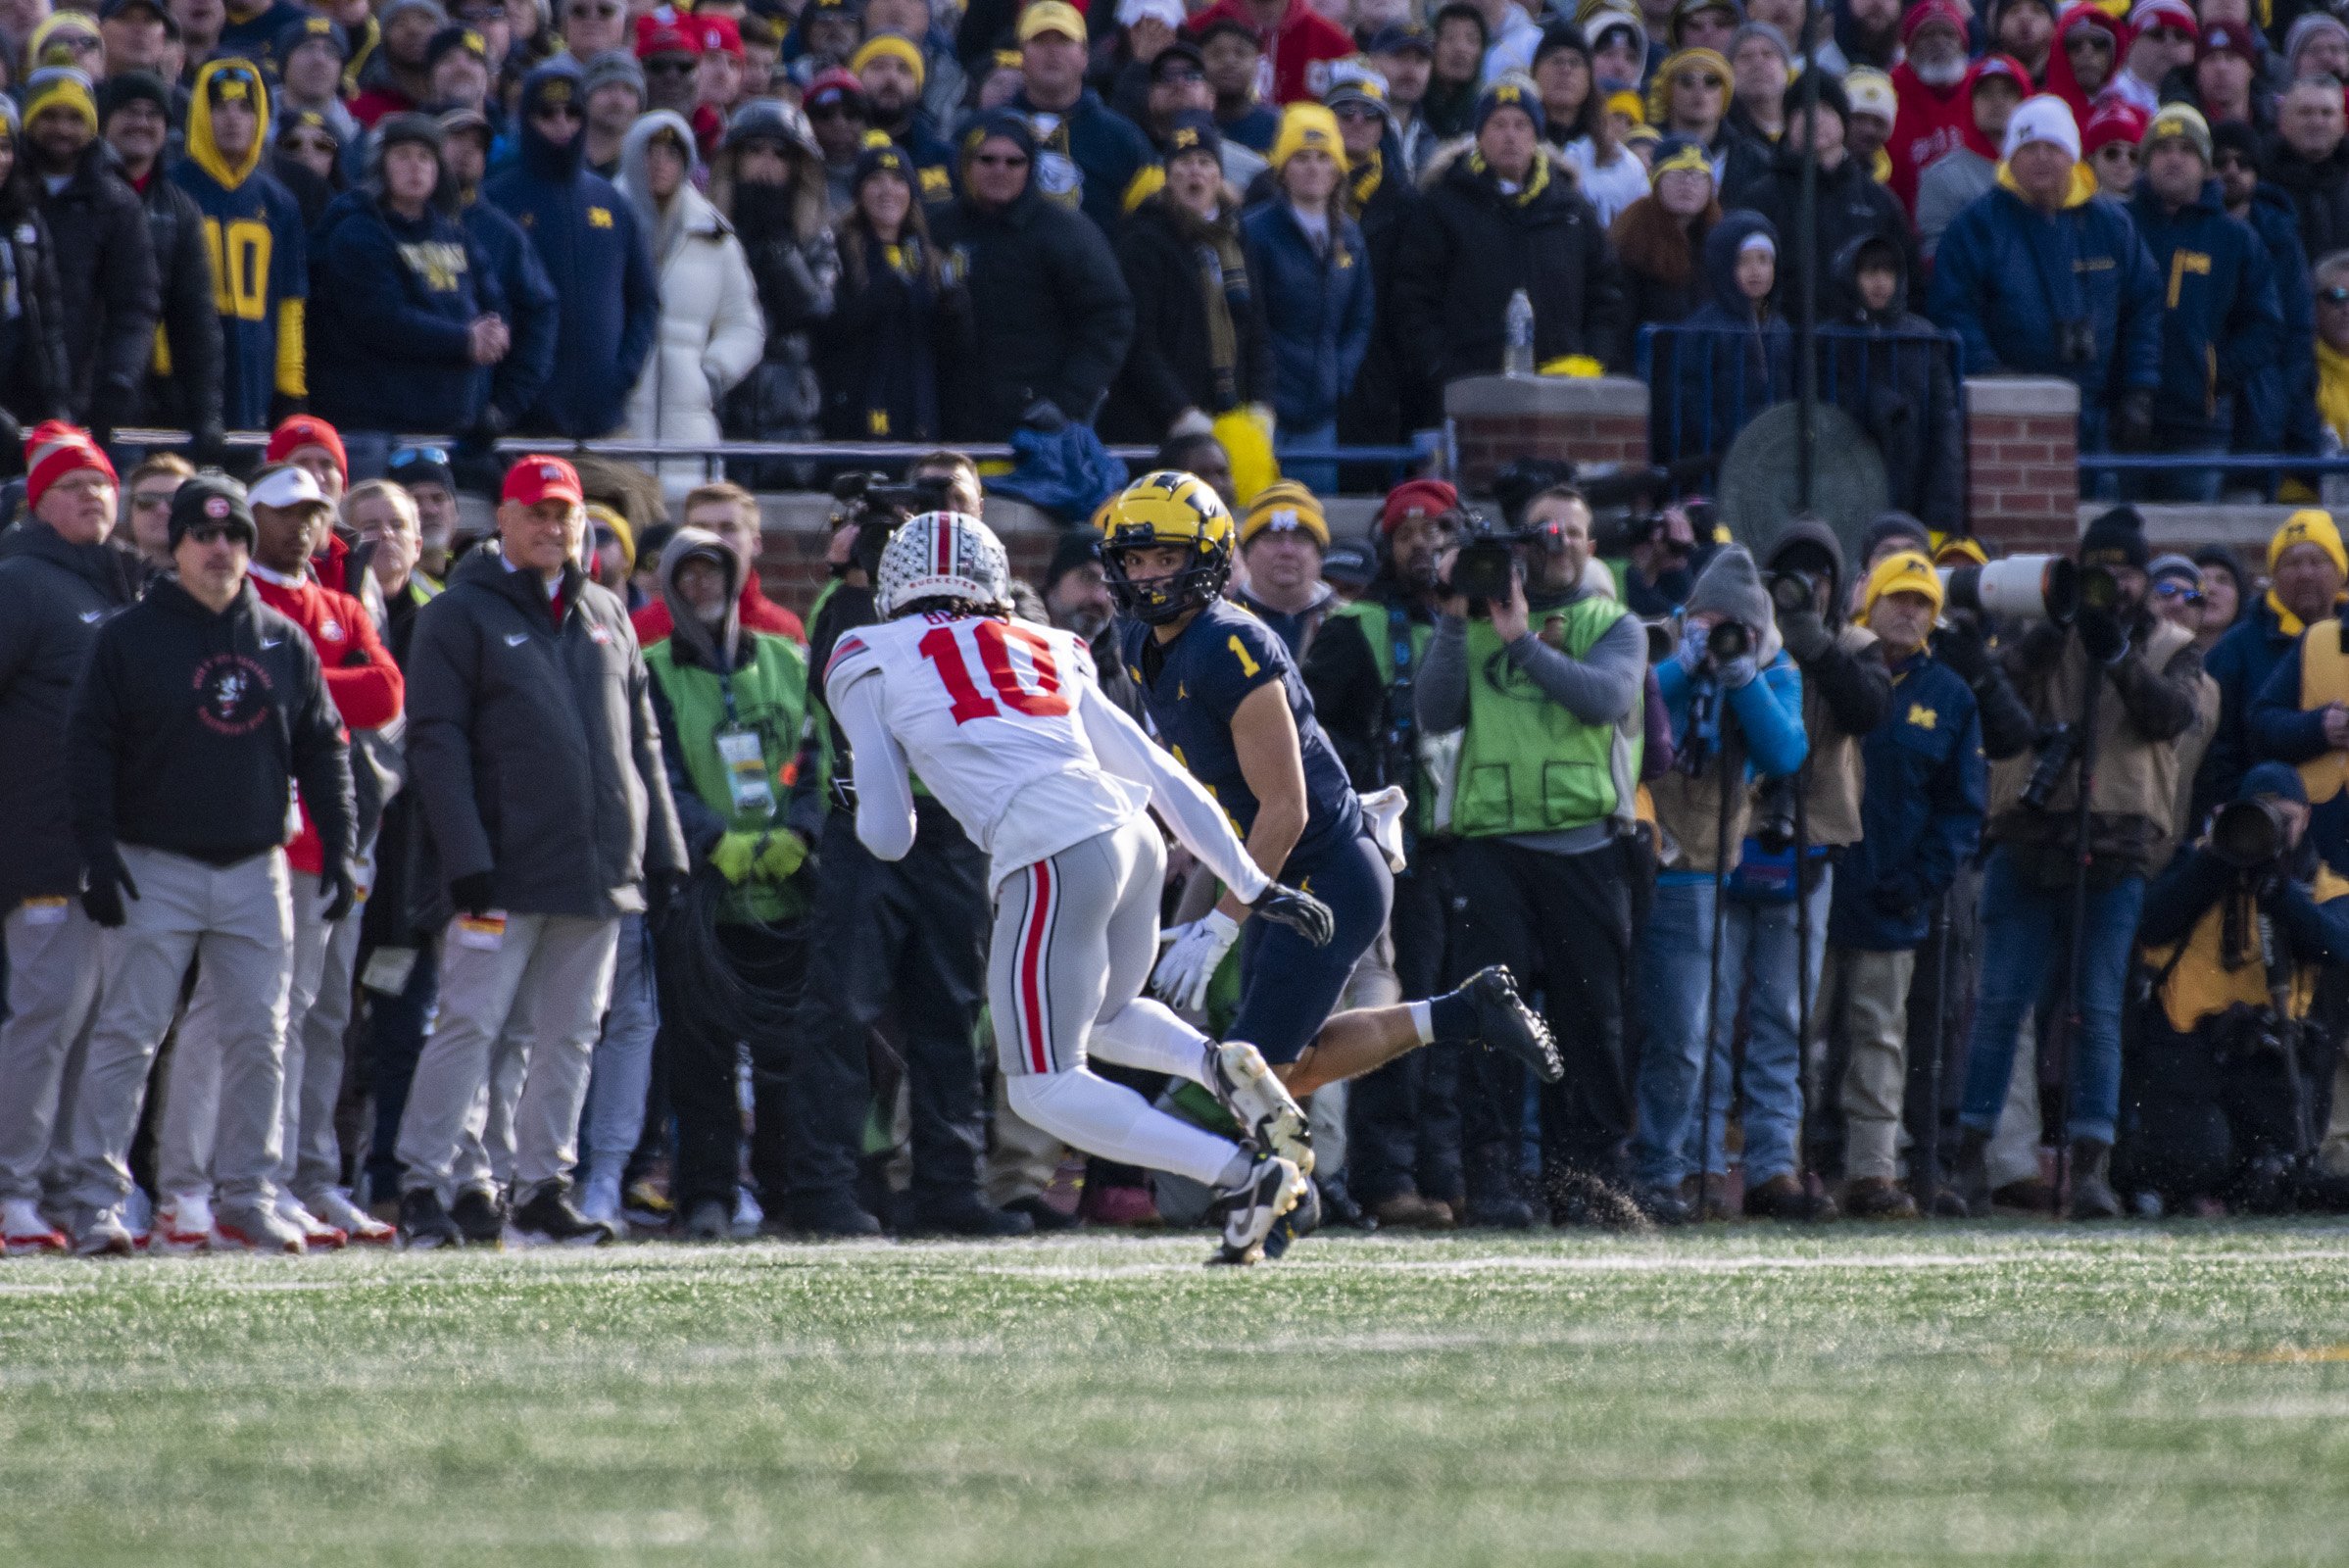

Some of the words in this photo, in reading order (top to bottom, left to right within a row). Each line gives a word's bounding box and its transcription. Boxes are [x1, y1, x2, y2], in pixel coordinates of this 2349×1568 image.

[1270, 509, 1298, 532] M
[908, 577, 977, 592] BUCKEYES
[1227, 634, 1261, 679] 1
[918, 619, 1071, 727] 10
[1907, 703, 1937, 729] M
